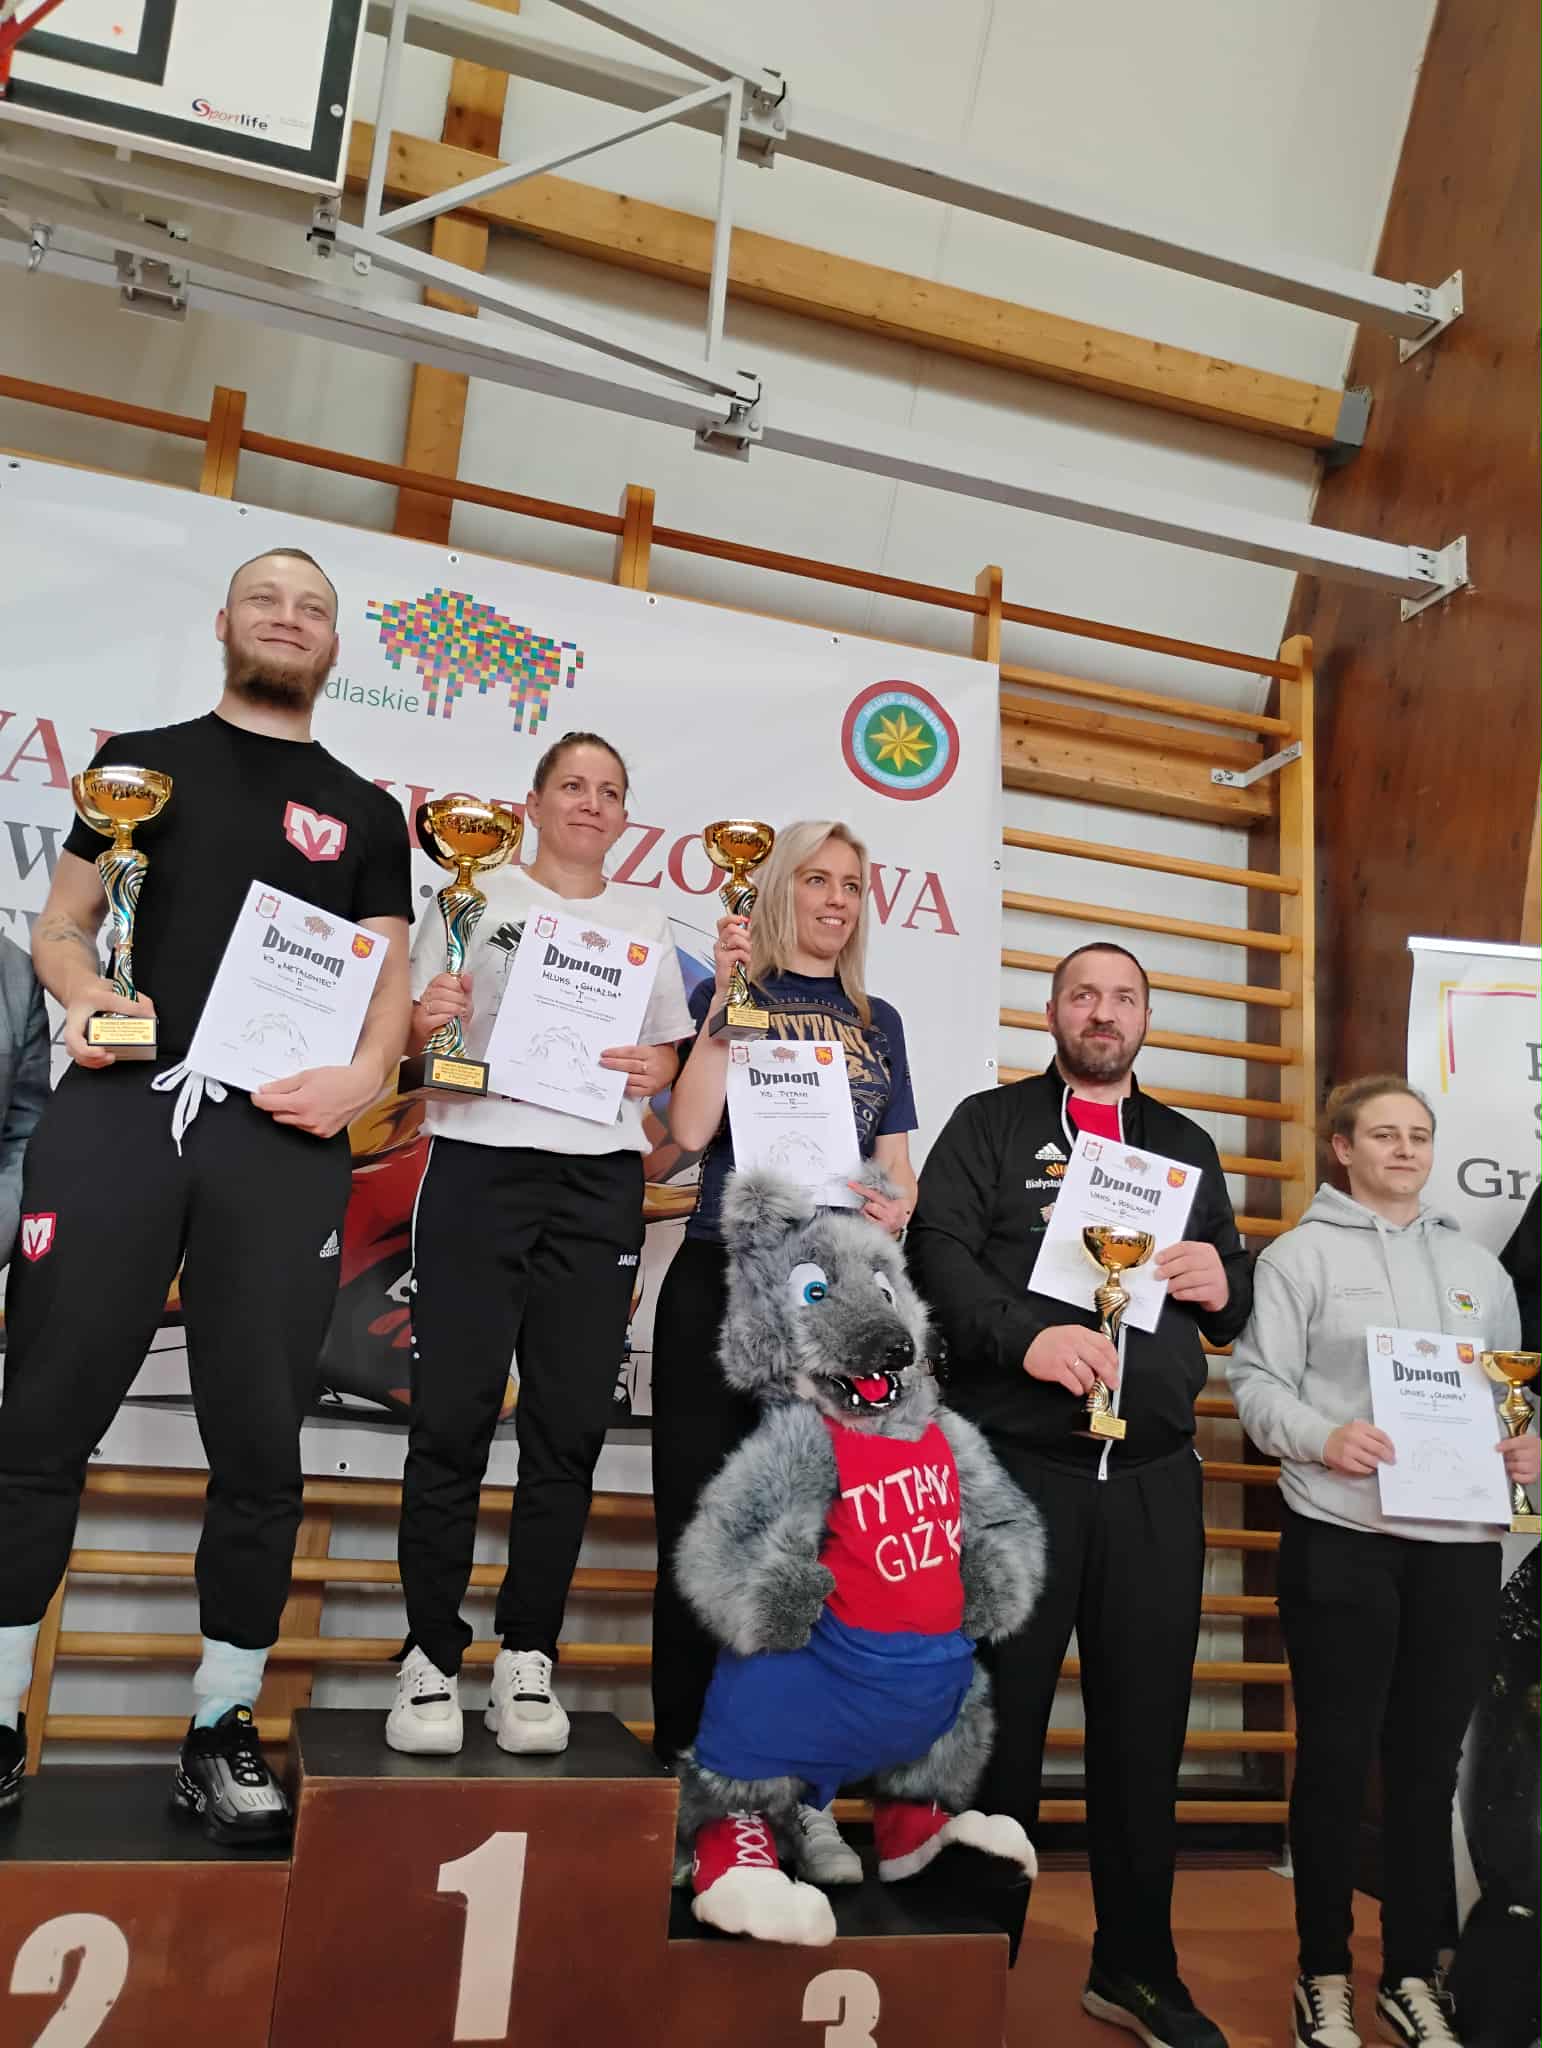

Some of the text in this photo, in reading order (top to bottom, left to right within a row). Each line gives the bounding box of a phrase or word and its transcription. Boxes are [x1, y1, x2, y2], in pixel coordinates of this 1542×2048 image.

[191, 98, 268, 129] Sportlife
[325, 677, 419, 712] dlaskie
[262, 924, 345, 978] Dyplom
[543, 943, 622, 987] Dyplom
[748, 1067, 820, 1087] Dyplom
[1026, 1178, 1061, 1190] Białysto
[1089, 1166, 1162, 1206] Dyplom
[1392, 1360, 1462, 1388] Dyplom
[437, 1831, 527, 2041] 1
[9, 1913, 129, 2048] 2
[801, 1969, 880, 2048] 3
